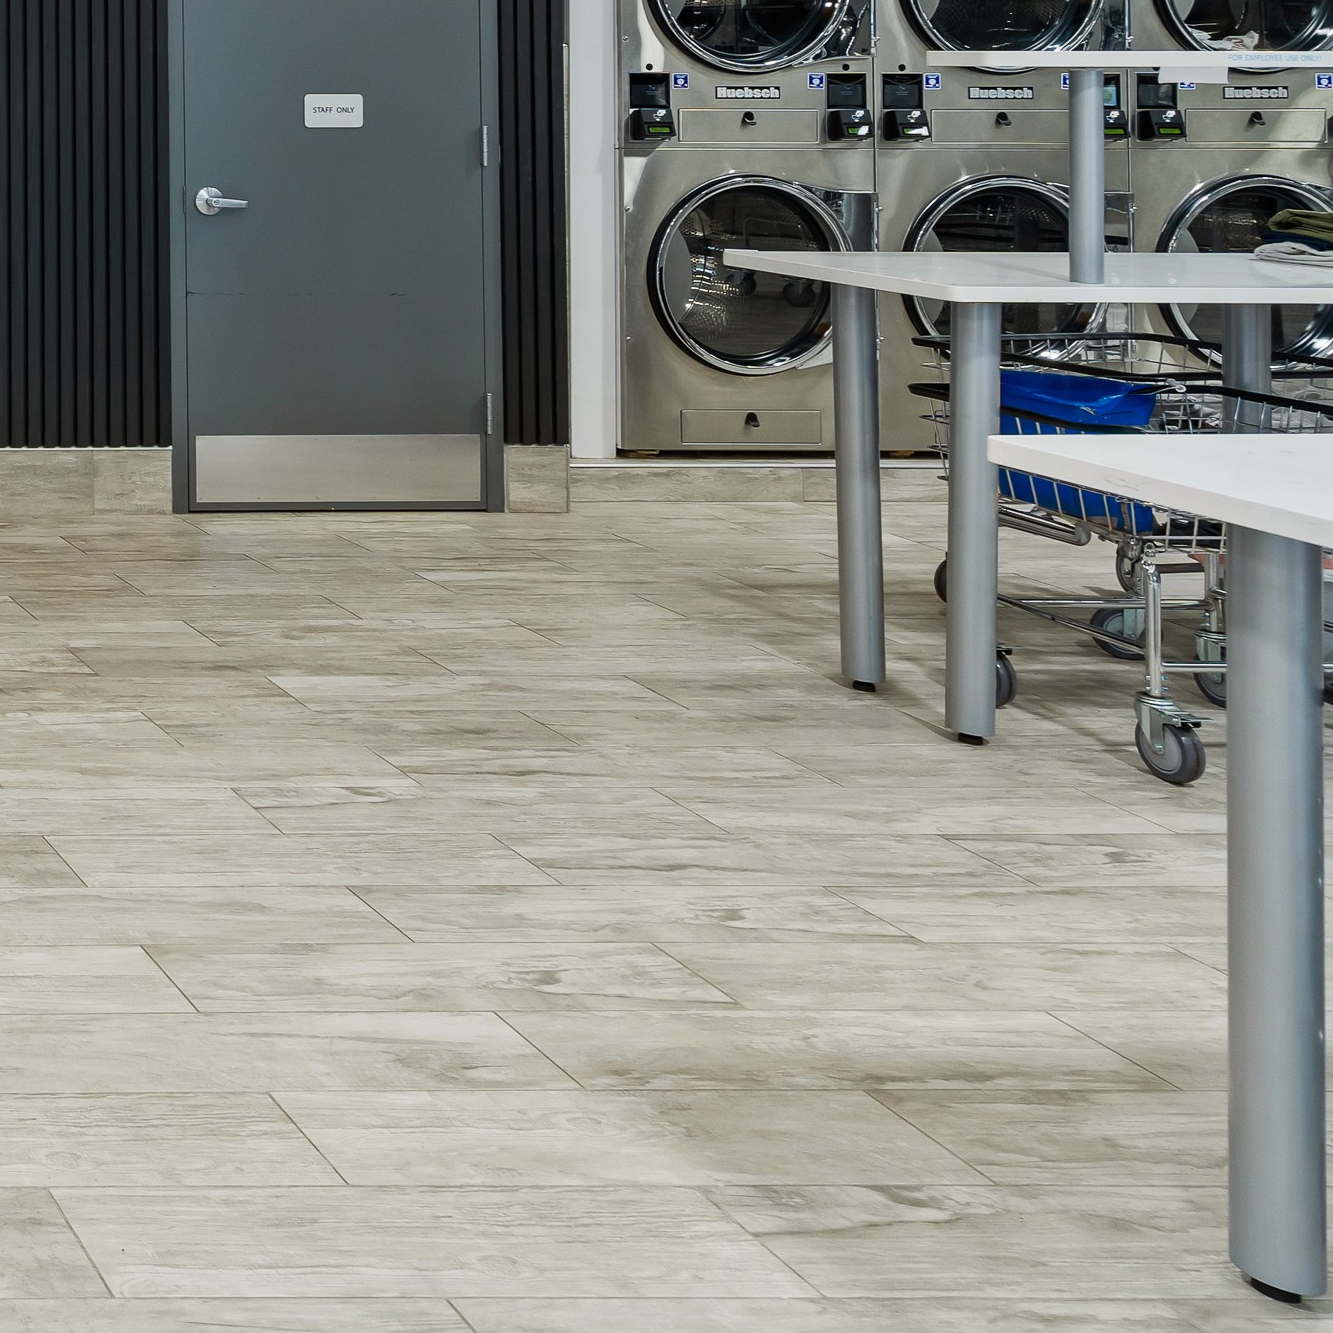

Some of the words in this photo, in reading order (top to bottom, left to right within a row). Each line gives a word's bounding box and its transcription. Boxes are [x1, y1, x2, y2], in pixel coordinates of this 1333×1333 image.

[716, 87, 780, 98] Huebsch
[969, 87, 1033, 98] Huebsch
[1224, 87, 1288, 98] Huebsch
[312, 106, 333, 114] STAFF
[336, 106, 355, 114] ONLY
